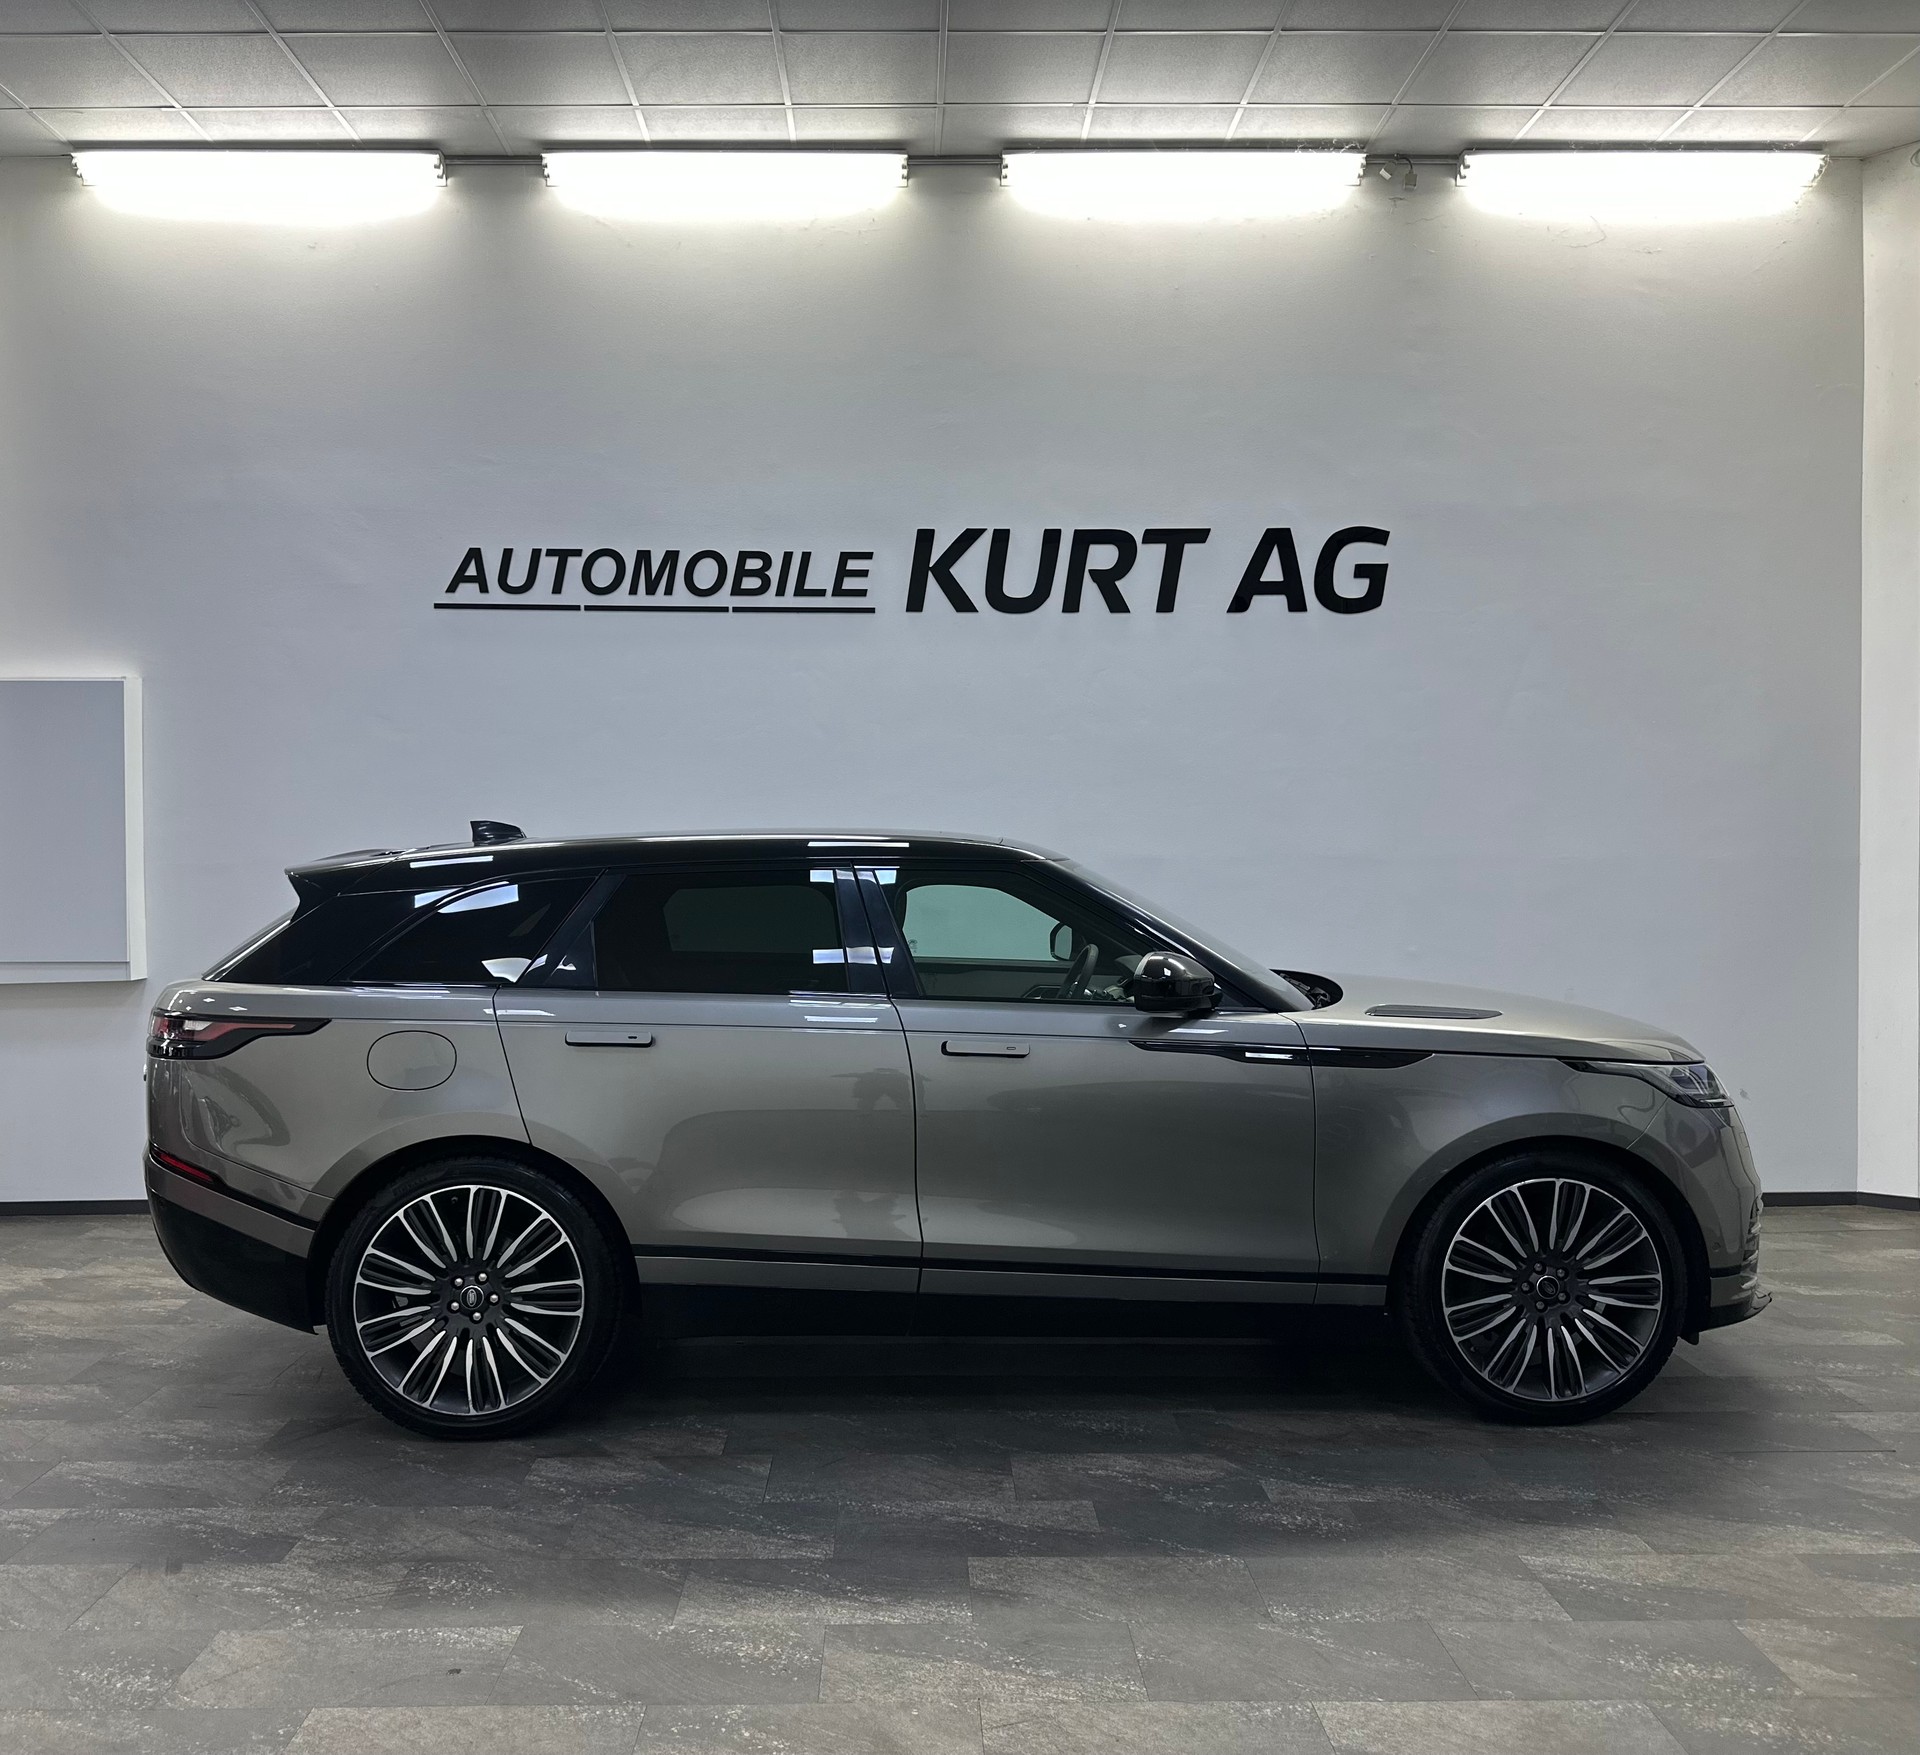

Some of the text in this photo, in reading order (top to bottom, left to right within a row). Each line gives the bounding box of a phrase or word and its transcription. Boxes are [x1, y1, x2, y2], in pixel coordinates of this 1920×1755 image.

[445, 525, 1391, 615] AUTOMOBILE KURT AG
